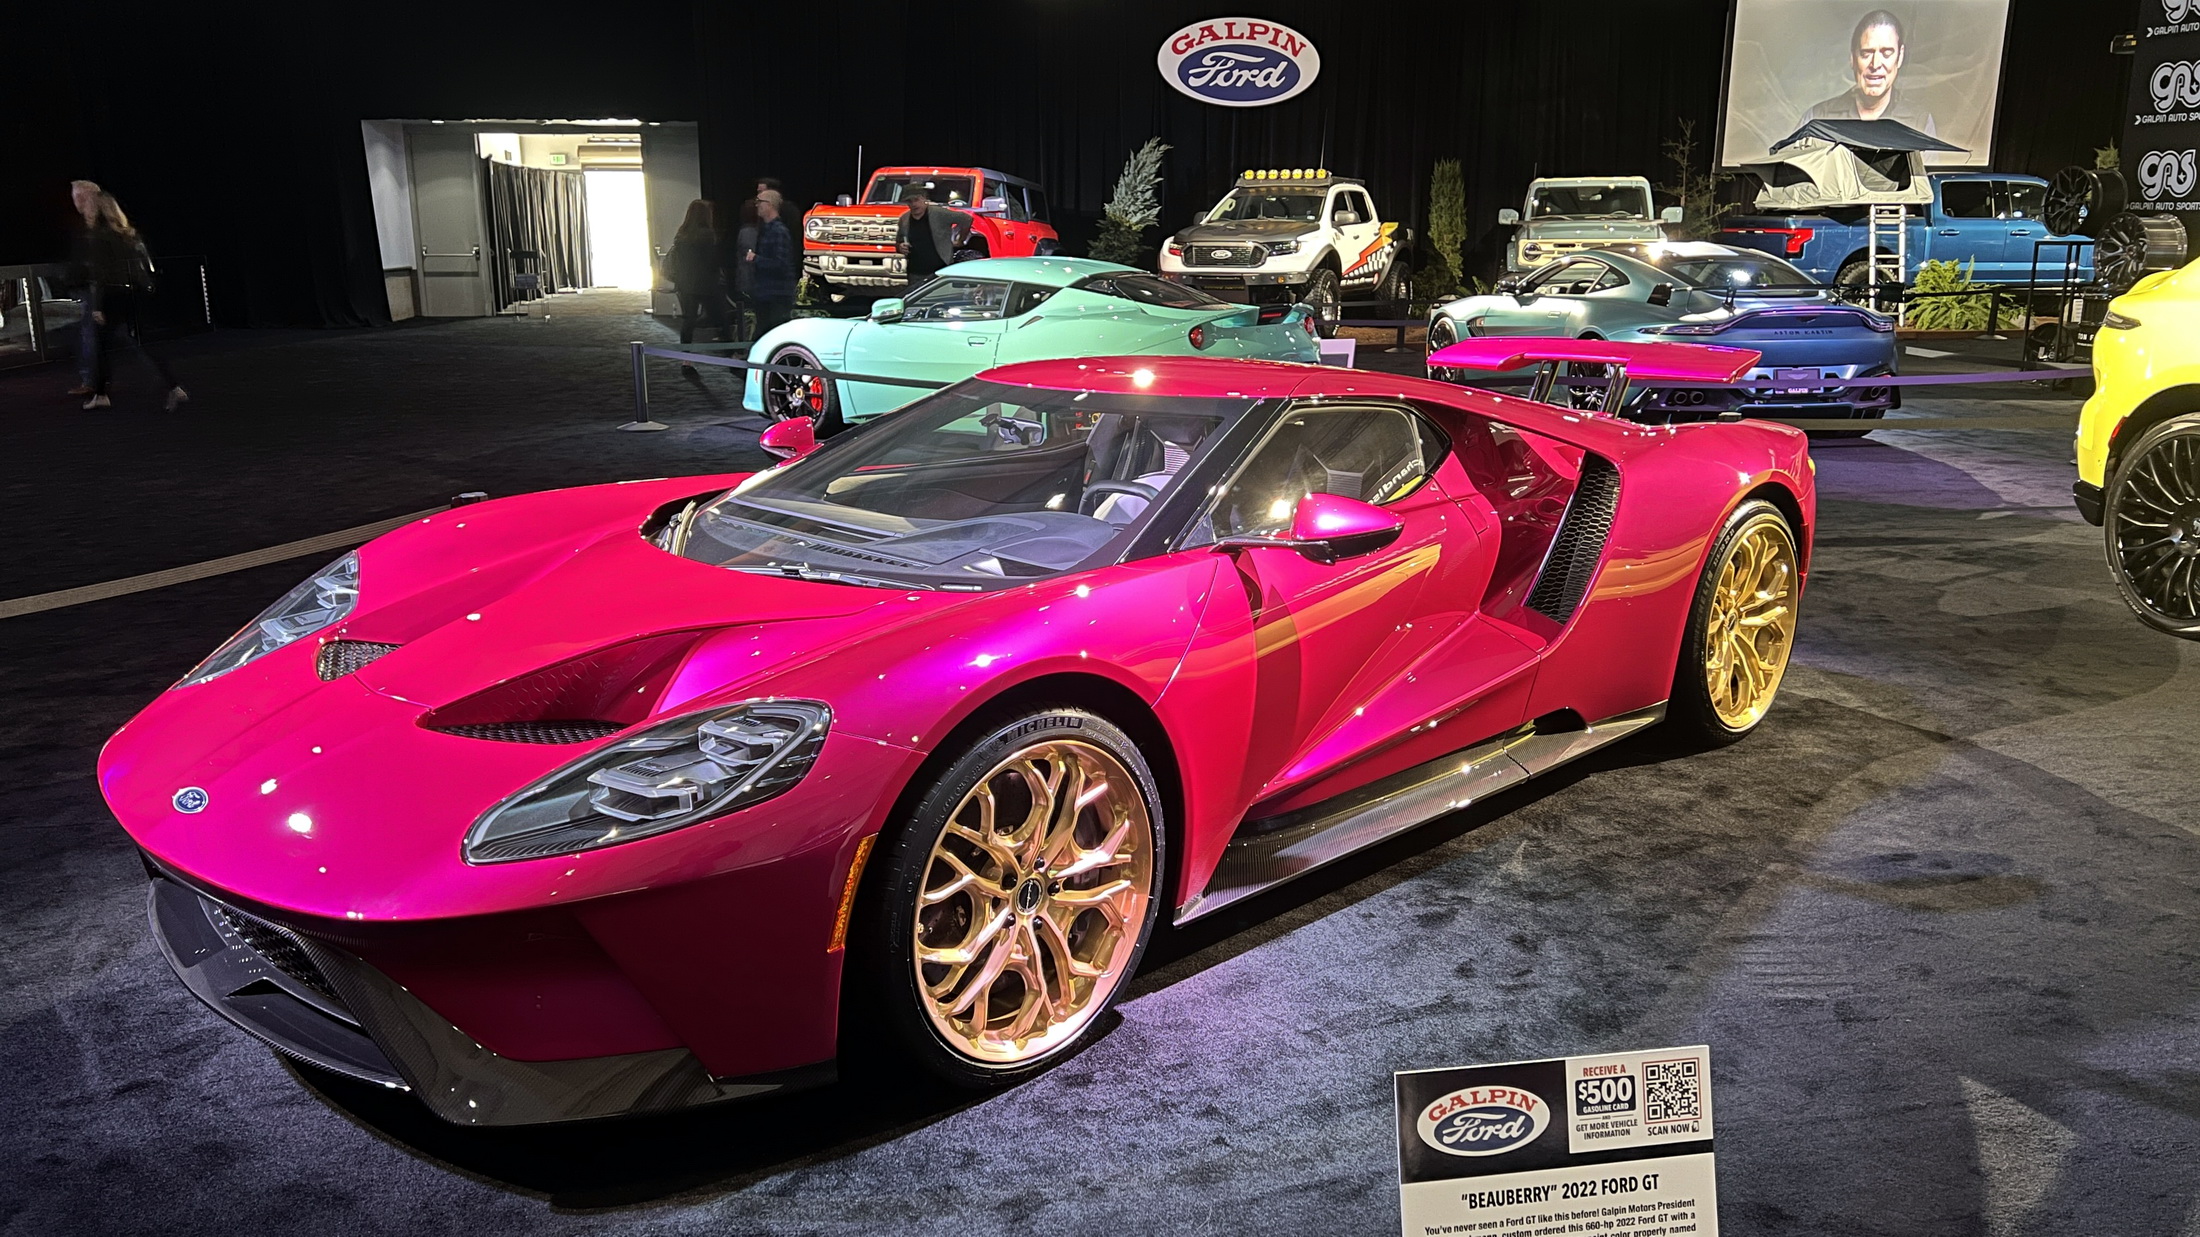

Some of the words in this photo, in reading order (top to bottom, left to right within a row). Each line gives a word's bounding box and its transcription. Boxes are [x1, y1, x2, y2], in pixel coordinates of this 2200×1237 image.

[2154, 24, 2179, 36] GALPIN
[2180, 22, 2200, 32] AUTO
[1171, 22, 1307, 57] GALPIN
[1188, 51, 1288, 88] Ford
[2142, 114, 2167, 124] GALPIN
[2168, 113, 2187, 122] AUTO
[2130, 202, 2154, 210] GALPIN
[2155, 202, 2174, 210] AUTO
[2176, 202, 2200, 210] SPORT
[1006, 717, 1081, 741] MICHELIN
[1583, 1065, 1619, 1077] RECEIVE
[1620, 1064, 1626, 1074] A
[1578, 1077, 1633, 1105] $500
[1428, 1089, 1538, 1121] GALPIN
[1582, 1104, 1612, 1114] GASOLINE
[1613, 1103, 1629, 1111] CARD
[1442, 1113, 1526, 1144] Ford
[1576, 1124, 1588, 1132] GET
[1589, 1121, 1609, 1131] MORE
[1610, 1119, 1638, 1128] VEHICLE
[1584, 1128, 1631, 1140] INFORMATION
[1647, 1126, 1669, 1136] SCAN
[1670, 1123, 1690, 1133] NOW
[1461, 1184, 1557, 1209] "BEAUBERRY"
[1562, 1180, 1597, 1199] 2022
[1602, 1176, 1638, 1195] FORD
[1642, 1174, 1659, 1190] GT
[1425, 1225, 1452, 1236] You've
[1453, 1223, 1476, 1233] never
[1478, 1221, 1498, 1230] seen
[1506, 1216, 1524, 1227] Ford
[1525, 1215, 1536, 1225] GT
[1537, 1214, 1553, 1224] like
[1554, 1212, 1570, 1221] this
[1571, 1208, 1600, 1220] before!
[1601, 1206, 1626, 1217] Galpin
[1628, 1203, 1656, 1213] Motors
[1657, 1198, 1695, 1210] President
[1534, 1224, 1566, 1236] ordered
[1568, 1223, 1583, 1232] this
[1585, 1220, 1614, 1230] 660-hp
[1616, 1217, 1636, 1227] 2022
[1638, 1215, 1656, 1225] Ford
[1658, 1213, 1668, 1222] GT
[1670, 1211, 1688, 1221] with
[1634, 1226, 1667, 1237] properly
[1669, 1222, 1696, 1234] named
